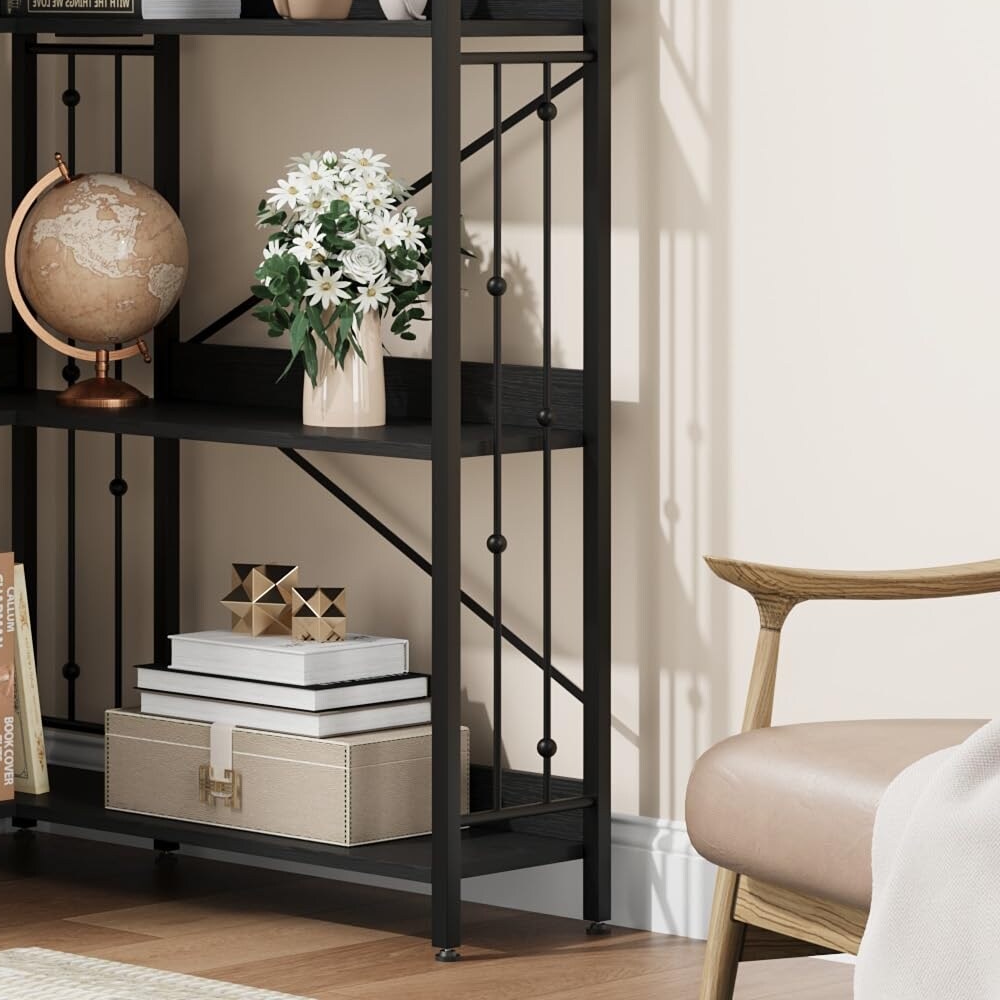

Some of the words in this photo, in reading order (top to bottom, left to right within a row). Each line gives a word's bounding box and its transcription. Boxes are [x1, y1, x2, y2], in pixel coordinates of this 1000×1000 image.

[6, 586, 15, 633] CALLUM
[4, 716, 14, 748] BOOK
[4, 748, 14, 786] COVER
